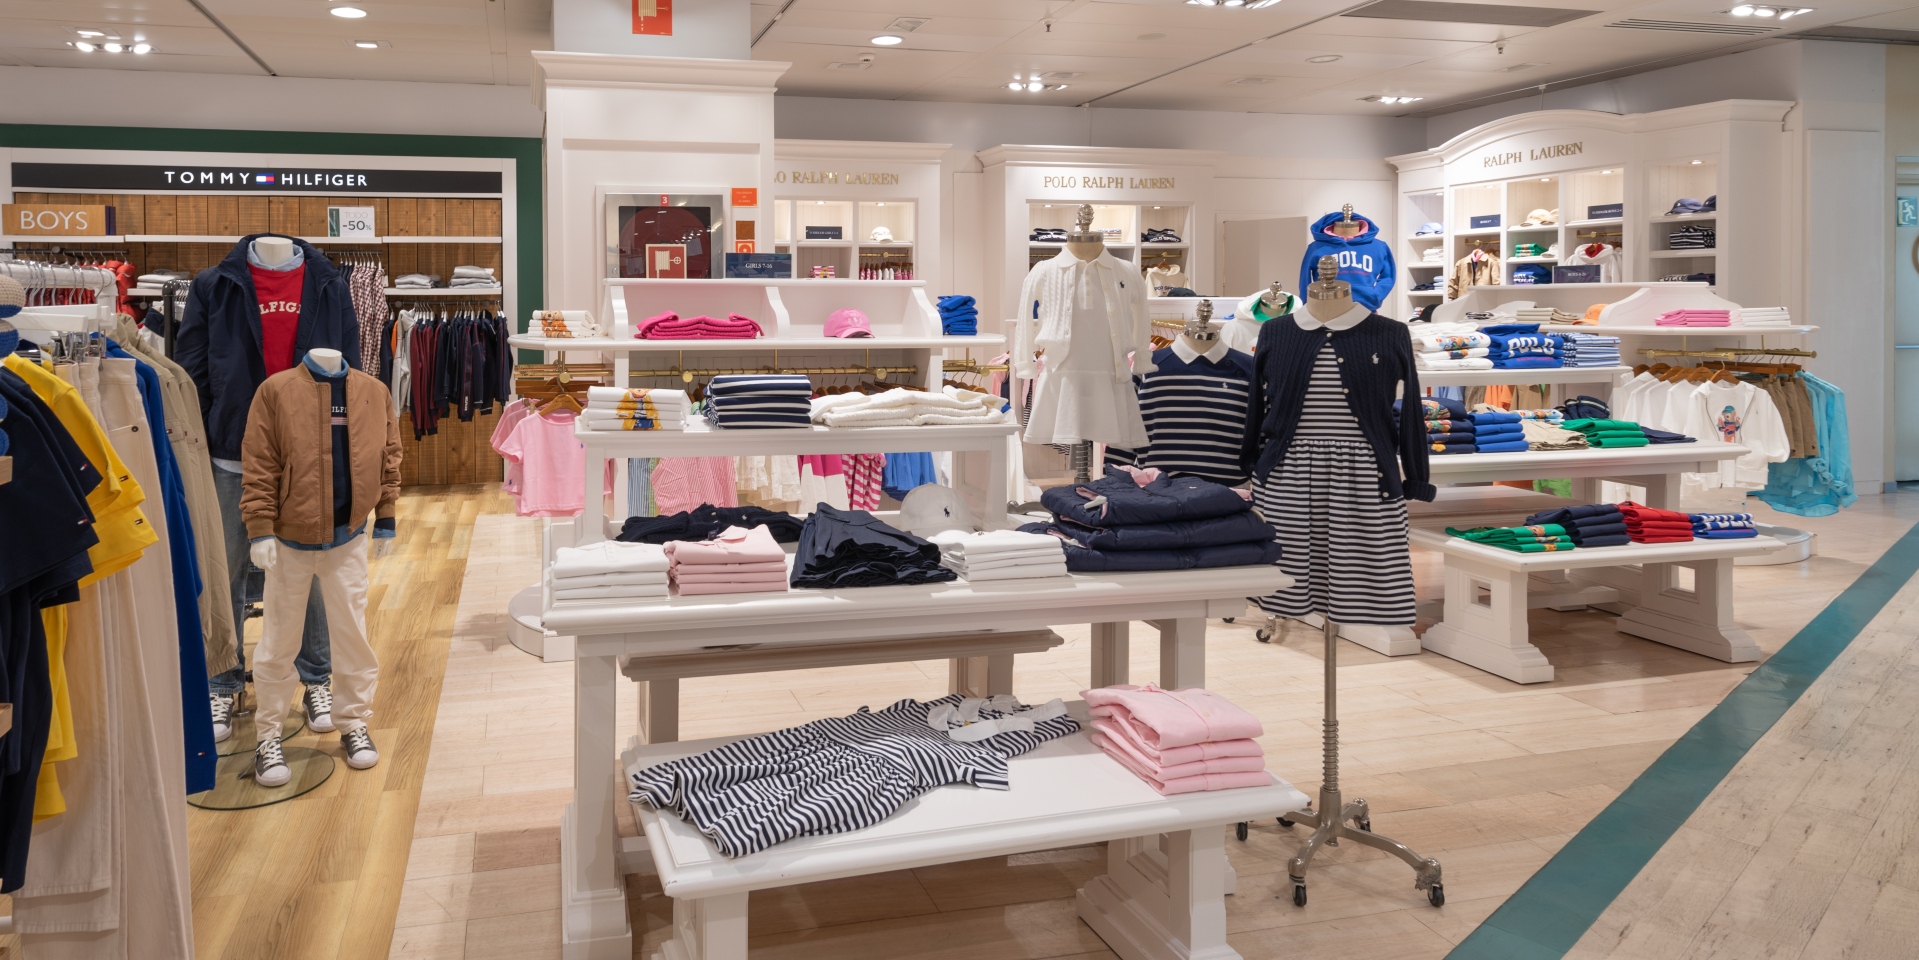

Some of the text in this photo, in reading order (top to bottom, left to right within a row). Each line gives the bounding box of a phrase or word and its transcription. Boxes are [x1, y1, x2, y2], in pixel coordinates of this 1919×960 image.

[1484, 141, 1583, 168] RALPH LAUREN
[164, 171, 368, 187] TOMMY HILFIGER
[792, 171, 839, 184] RALPH
[845, 173, 899, 185] LAUREN
[1043, 176, 1175, 189] POLO RALPH LAUREN
[662, 196, 668, 204] 3
[20, 210, 88, 230] BOYS
[342, 220, 372, 231] -50%
[259, 301, 302, 315] LFIG
